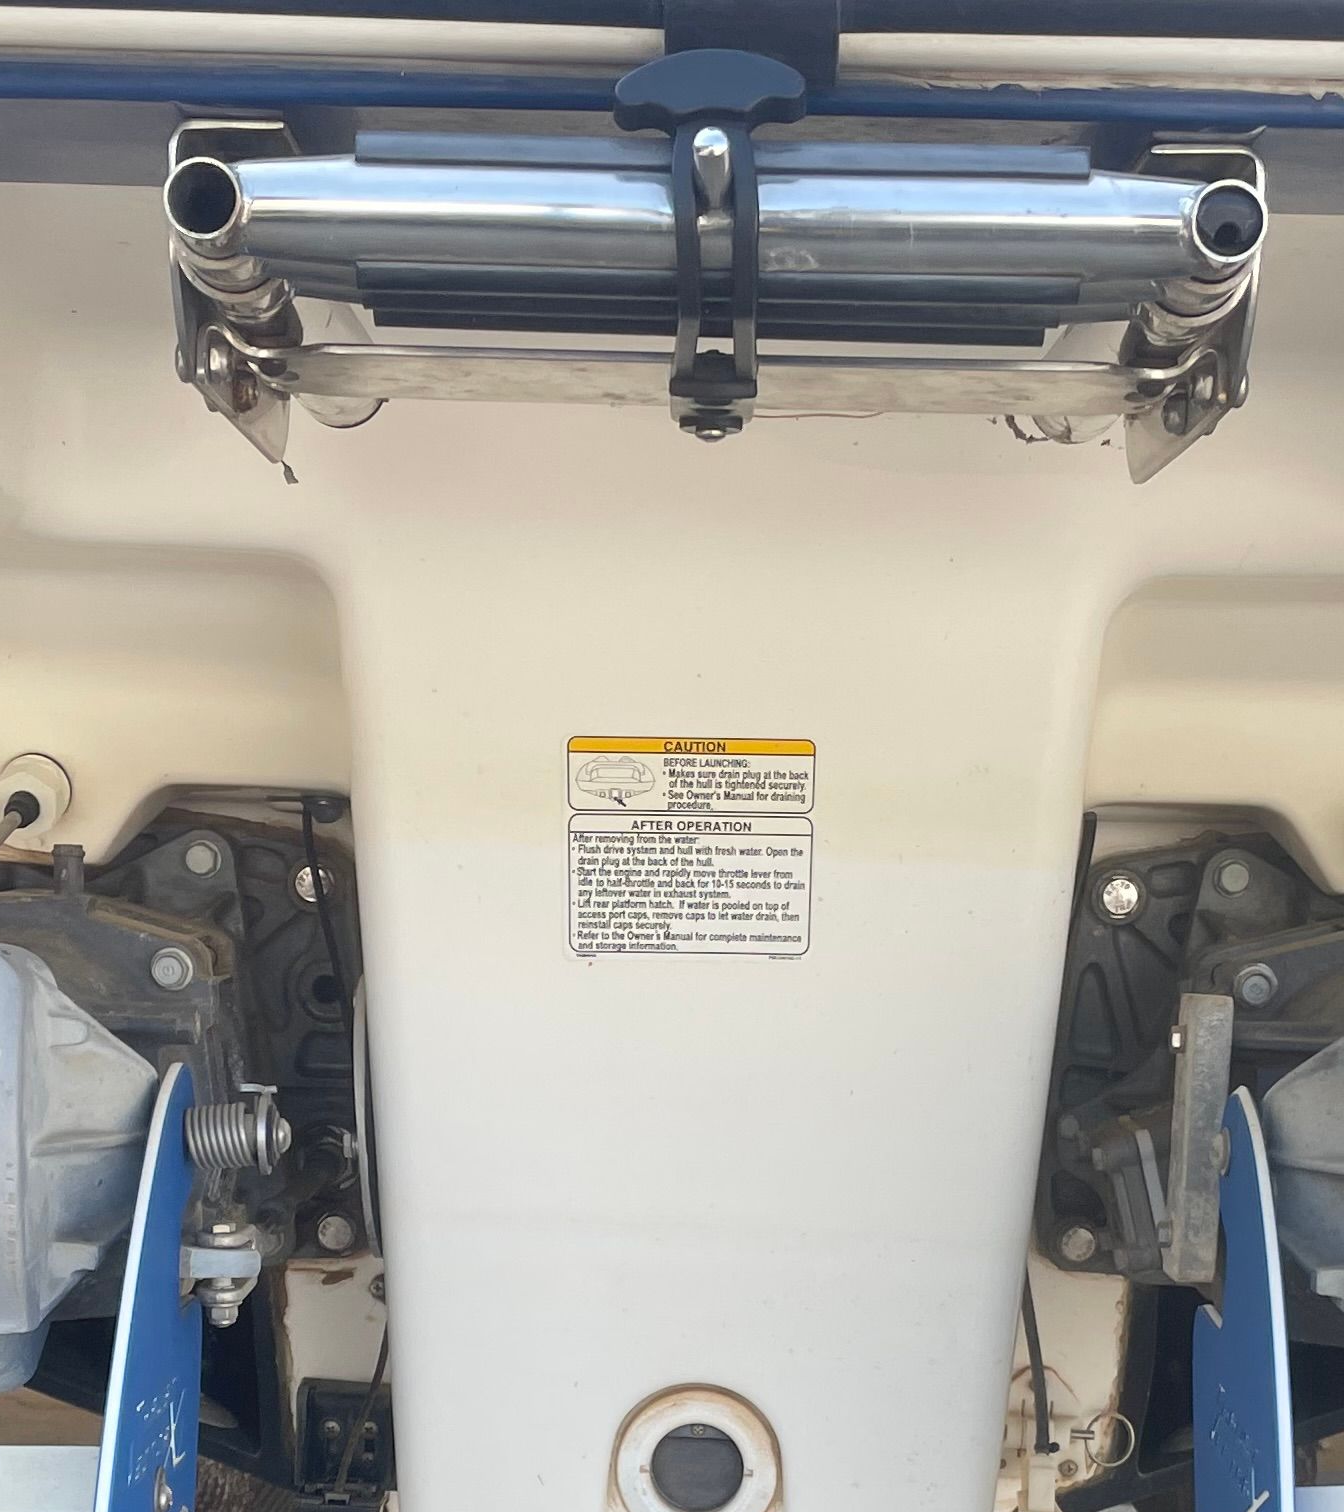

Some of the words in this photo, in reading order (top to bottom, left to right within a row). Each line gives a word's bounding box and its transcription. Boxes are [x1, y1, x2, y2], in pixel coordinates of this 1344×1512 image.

[663, 742, 726, 752] CAUTION
[663, 758, 697, 767] BEFORE
[699, 759, 750, 768] LAUNCHING:
[669, 769, 695, 778] Makes
[718, 770, 740, 779] drain
[742, 770, 761, 780] plug
[764, 771, 771, 779] at
[774, 771, 786, 780] the
[789, 771, 808, 780] back
[669, 780, 678, 788] of
[680, 780, 694, 788] the
[696, 780, 712, 788] hull
[715, 780, 722, 788] is
[725, 780, 766, 790] tightened
[768, 781, 806, 791] securely.
[668, 791, 684, 799] See
[686, 791, 720, 800] Owner's
[724, 791, 754, 800] Manual
[756, 792, 768, 800] for
[770, 792, 806, 803] draining
[667, 801, 713, 810] procedure.
[631, 821, 672, 830] AFTER
[677, 822, 752, 831] OPERATION
[573, 833, 593, 842] After
[595, 835, 634, 845] removing
[637, 834, 656, 843] from
[659, 835, 671, 843] the
[578, 844, 601, 854] Flush
[604, 845, 624, 854] drive
[627, 847, 656, 855] system
[659, 846, 674, 854] and
[677, 846, 693, 854] hull
[695, 846, 712, 855] with
[716, 846, 736, 856] fresh
[739, 848, 763, 856] water.
[766, 847, 788, 858] Open
[791, 848, 803, 856] the
[578, 856, 599, 865] drain
[602, 857, 619, 868] plug
[622, 857, 630, 865] at
[632, 857, 645, 865] the
[648, 857, 667, 866] back
[670, 857, 678, 866] of
[681, 857, 694, 866] the
[697, 858, 714, 866] hull.
[577, 867, 596, 876] Start
[599, 867, 611, 876] the
[614, 869, 642, 879] engine
[662, 868, 691, 880] rapidly
[719, 869, 748, 878] throttle
[751, 870, 771, 878] lever
[774, 870, 793, 879] from
[578, 877, 592, 886] idle
[596, 878, 604, 886] to
[657, 879, 672, 887] and
[675, 878, 694, 888] back
[697, 879, 709, 888] for
[712, 880, 733, 888] 10-15
[736, 880, 771, 889] seconds
[774, 880, 782, 889] to
[784, 880, 805, 890] drain
[578, 890, 592, 900] any
[595, 889, 626, 897] leftover
[654, 889, 661, 897] in
[664, 890, 696, 898] exhaust
[699, 891, 731, 900] system.
[578, 899, 591, 908] Lift
[612, 900, 646, 910] platform
[649, 900, 674, 908] hatch.
[679, 900, 685, 909] If
[687, 901, 709, 910] water
[712, 901, 719, 910] is
[722, 902, 750, 911] pooled
[765, 902, 779, 912] top
[781, 902, 790, 910] of
[609, 911, 625, 921] port
[628, 912, 650, 921] caps,
[685, 914, 705, 922] caps
[708, 912, 716, 920] to
[718, 912, 728, 920] let
[781, 913, 800, 921] then
[578, 920, 611, 929] reinstall
[613, 922, 633, 930] caps
[635, 921, 672, 932] securely.
[577, 931, 599, 939] Refer
[601, 932, 609, 940] to
[612, 932, 625, 940] the
[627, 931, 660, 940] Owner's
[664, 933, 693, 941] Manual
[695, 932, 707, 941] for
[709, 932, 747, 943] complete
[750, 933, 802, 942] maintenance
[596, 942, 626, 952] storage
[629, 942, 679, 951] information.
